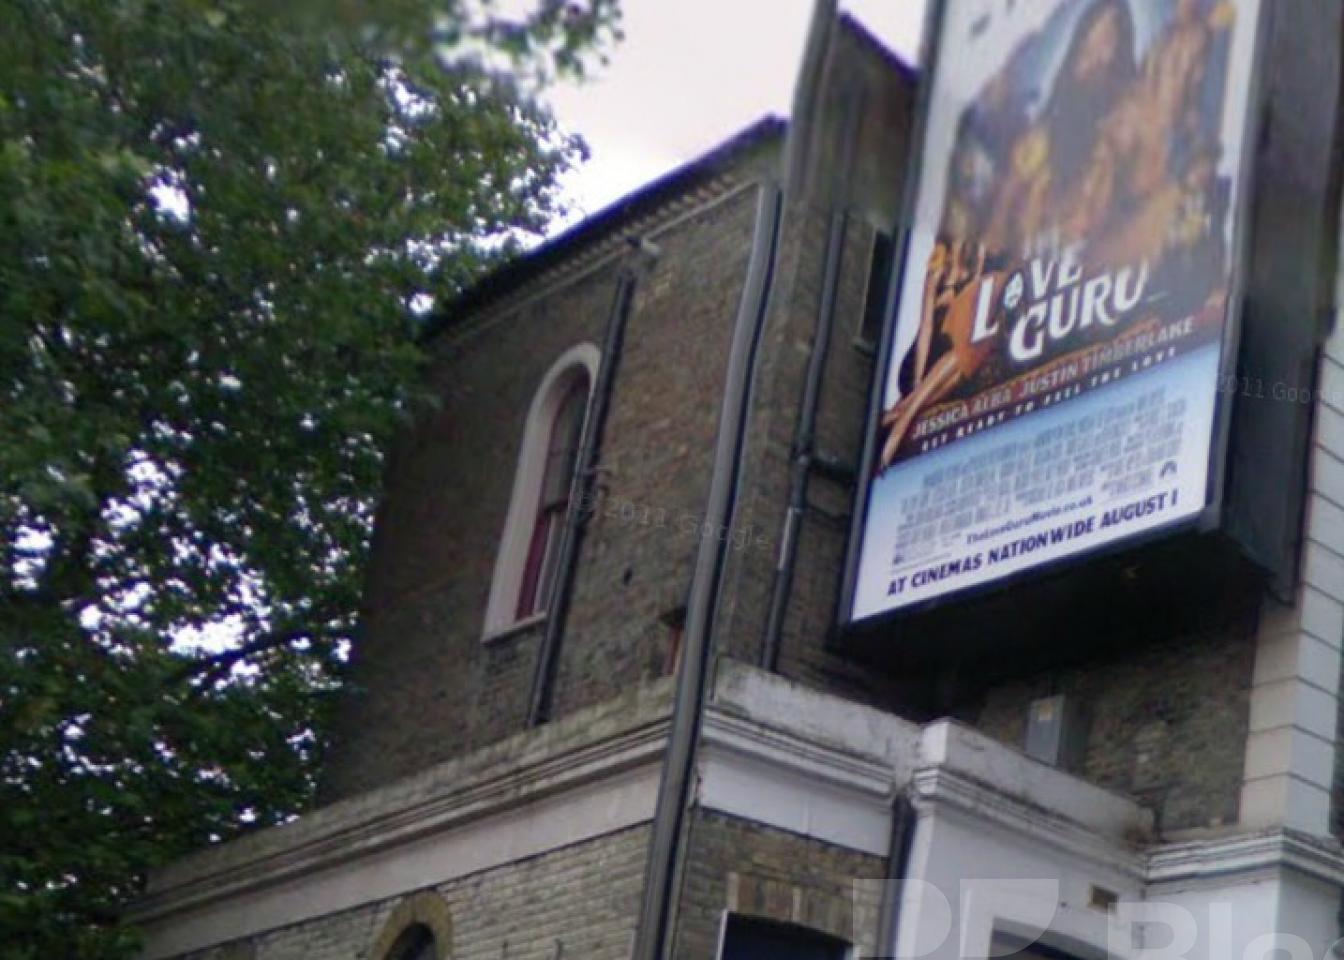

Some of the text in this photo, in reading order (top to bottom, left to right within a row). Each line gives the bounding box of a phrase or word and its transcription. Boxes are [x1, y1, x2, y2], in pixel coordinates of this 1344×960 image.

[1009, 255, 1150, 362] GURU
[887, 575, 908, 597] AT
[911, 553, 983, 589] CINEMAS
[987, 515, 1096, 566] NATIONWIDE
[1099, 492, 1169, 529] AUGUST
